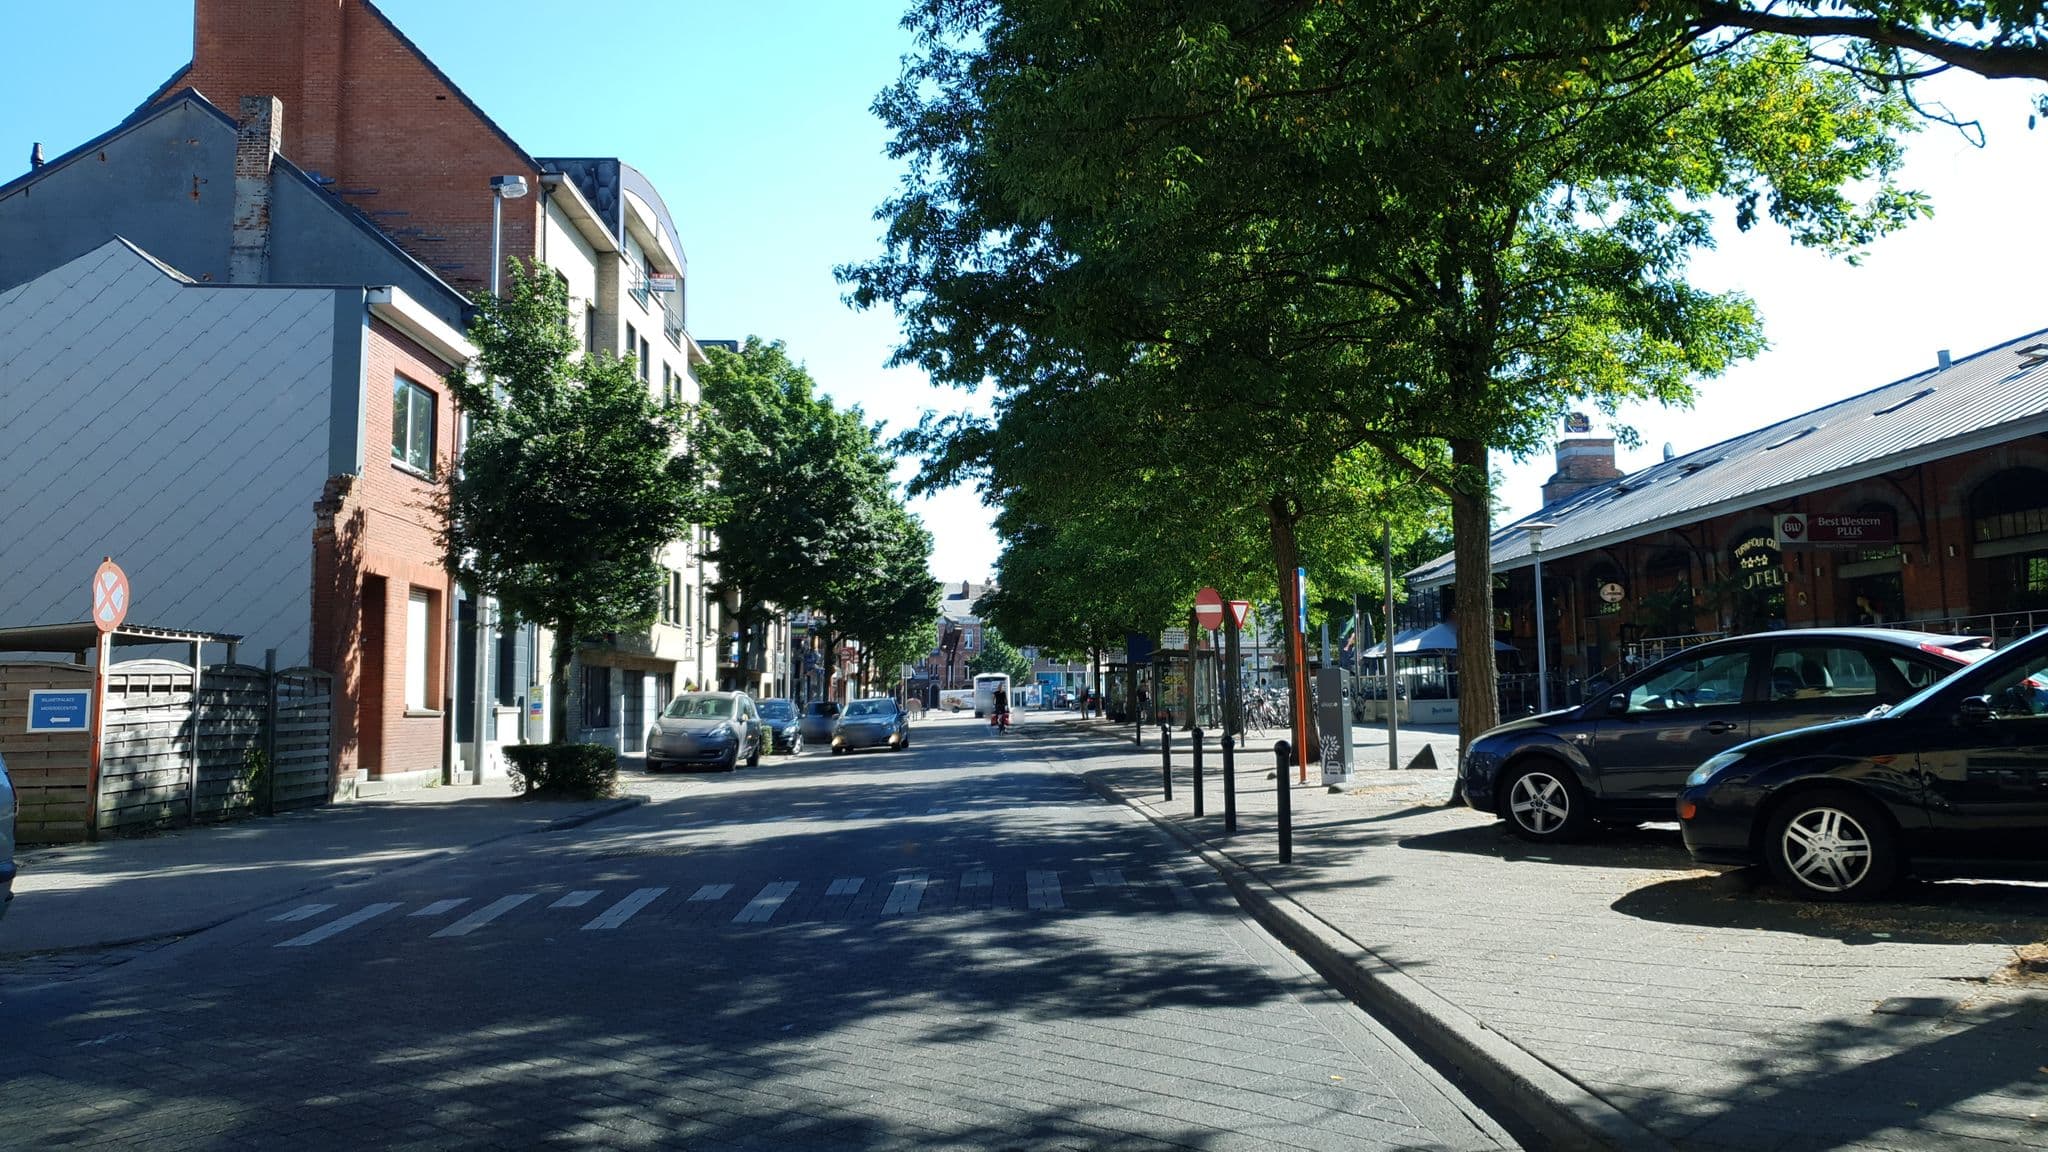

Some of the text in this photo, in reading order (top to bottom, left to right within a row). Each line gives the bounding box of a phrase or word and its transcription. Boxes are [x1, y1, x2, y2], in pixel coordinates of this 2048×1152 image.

[1784, 521, 1802, 533] BW
[1818, 516, 1881, 527] Best Western
[1837, 526, 1863, 537] PLUS
